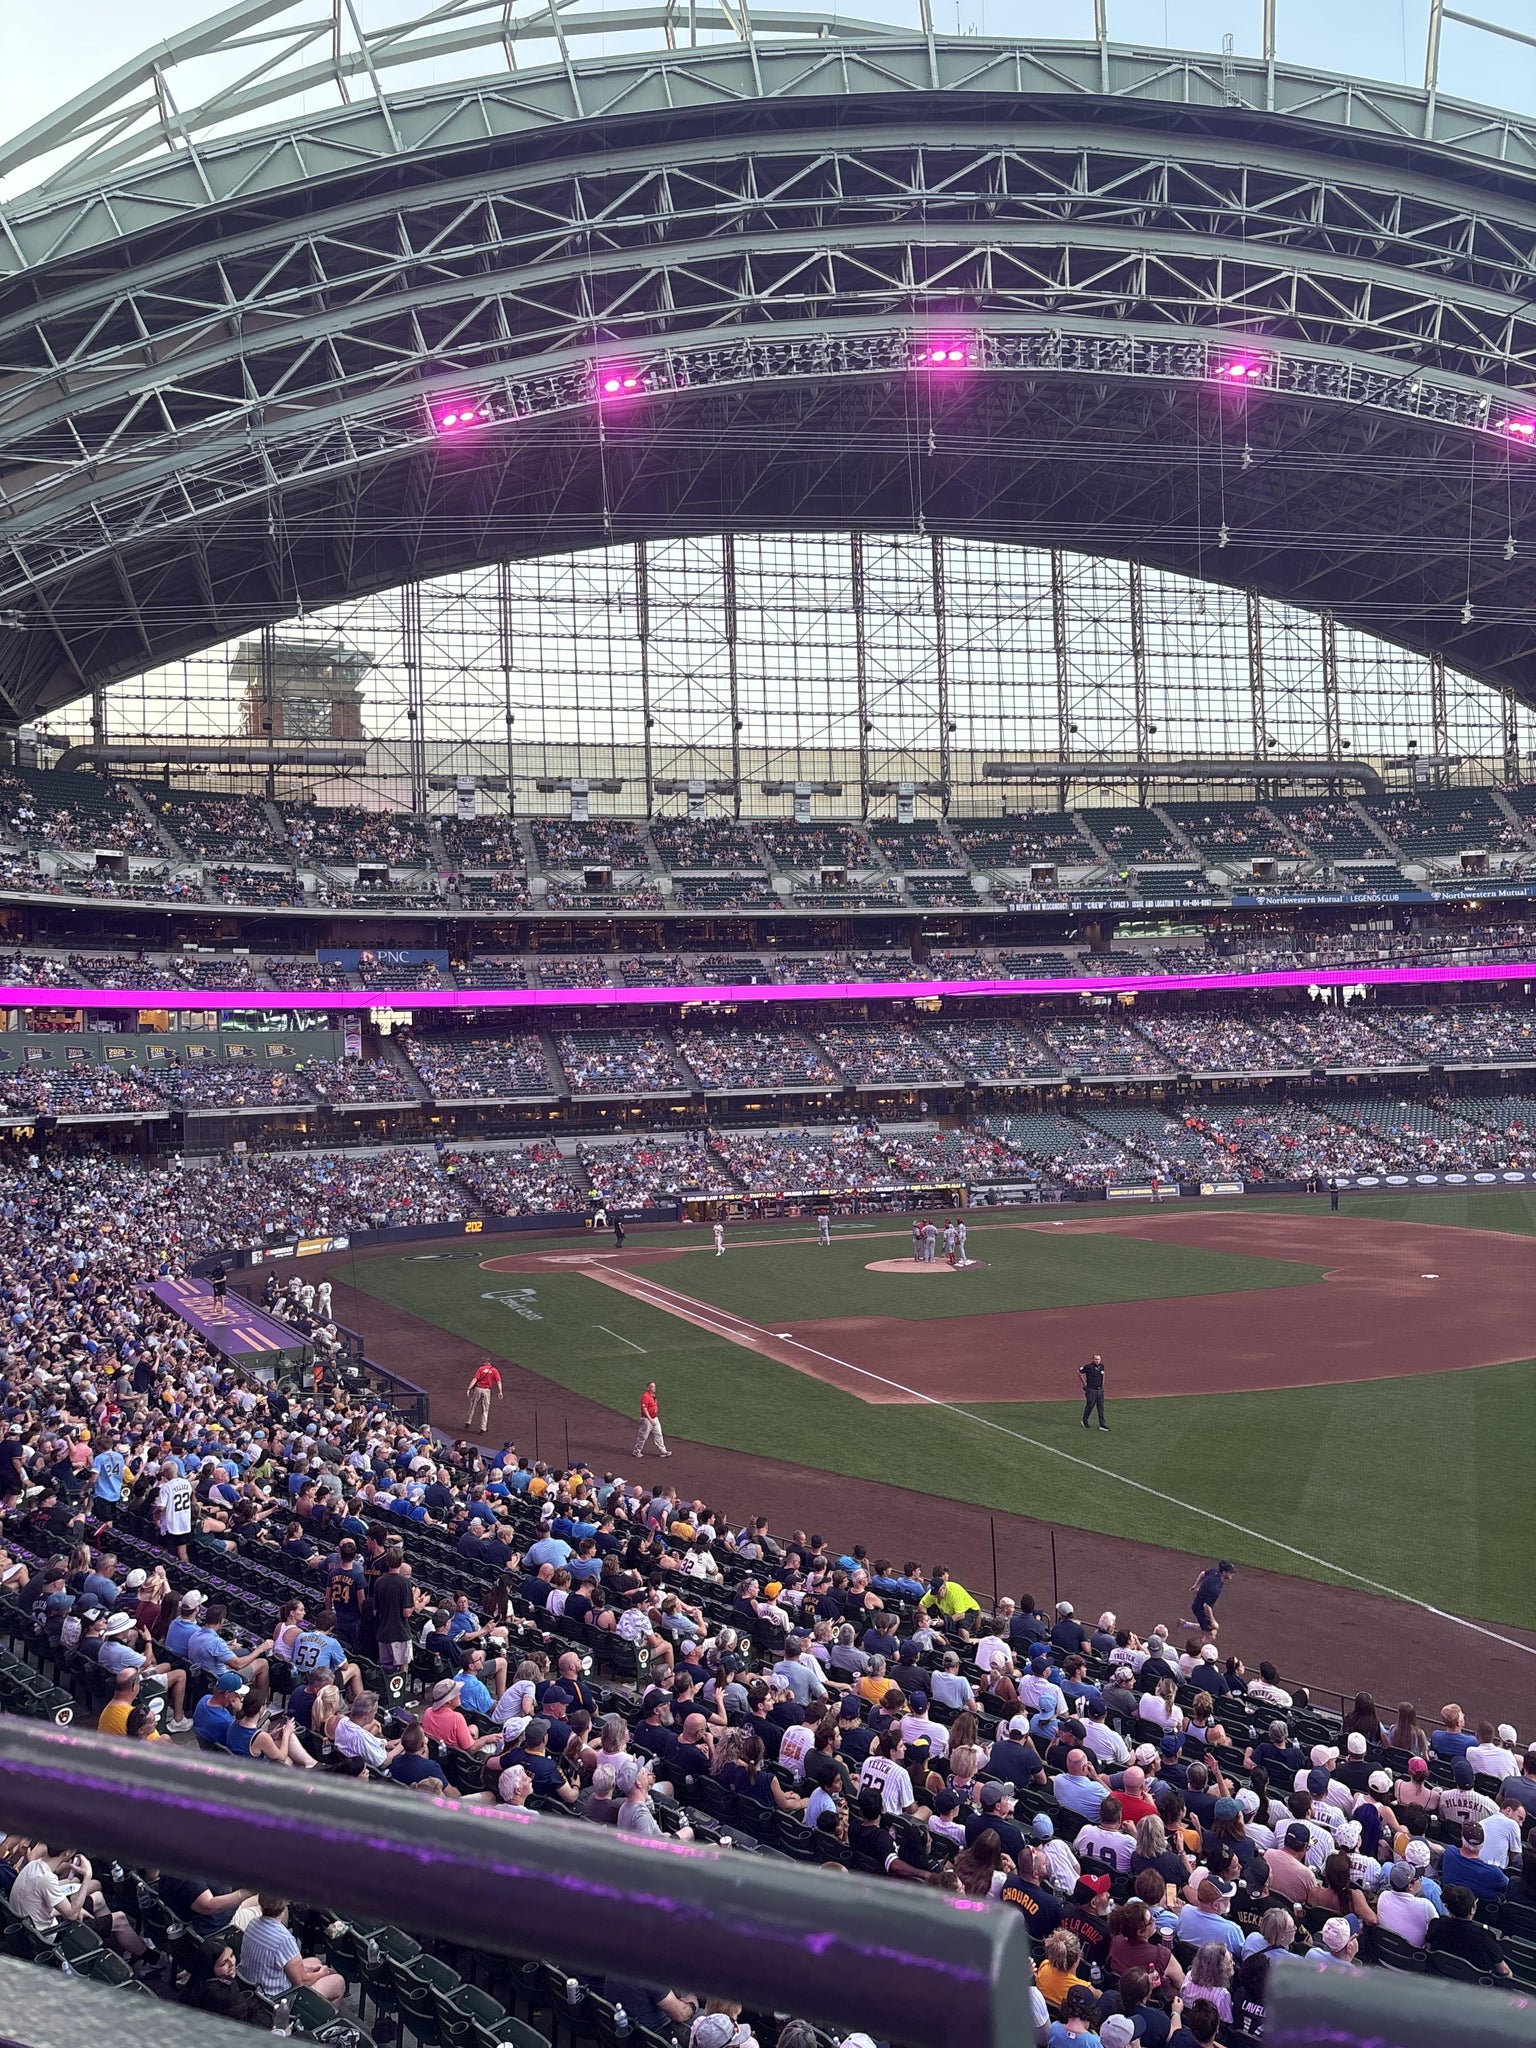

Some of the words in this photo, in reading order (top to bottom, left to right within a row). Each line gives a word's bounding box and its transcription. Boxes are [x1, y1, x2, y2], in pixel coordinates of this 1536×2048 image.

[1266, 896, 1315, 904] Northwestern
[1318, 895, 1342, 903] Mutual
[1442, 892, 1496, 900] Northwestern
[1498, 888, 1527, 896] Mutual
[378, 951, 410, 963] PNC
[465, 1221, 482, 1232] 202
[106, 1464, 120, 1478] 24
[174, 1492, 190, 1512] 22
[680, 1558, 694, 1575] 32
[332, 1584, 350, 1604] 24
[296, 1646, 320, 1668] 53
[868, 1760, 892, 1774] YELICH
[1445, 1798, 1483, 1812] PILARSKI
[1002, 1887, 1040, 1915] CHOURIO
[1238, 1911, 1262, 1928] UECKE
[1070, 1918, 1080, 1930] LA
[1080, 1921, 1104, 1944] CRUZ
